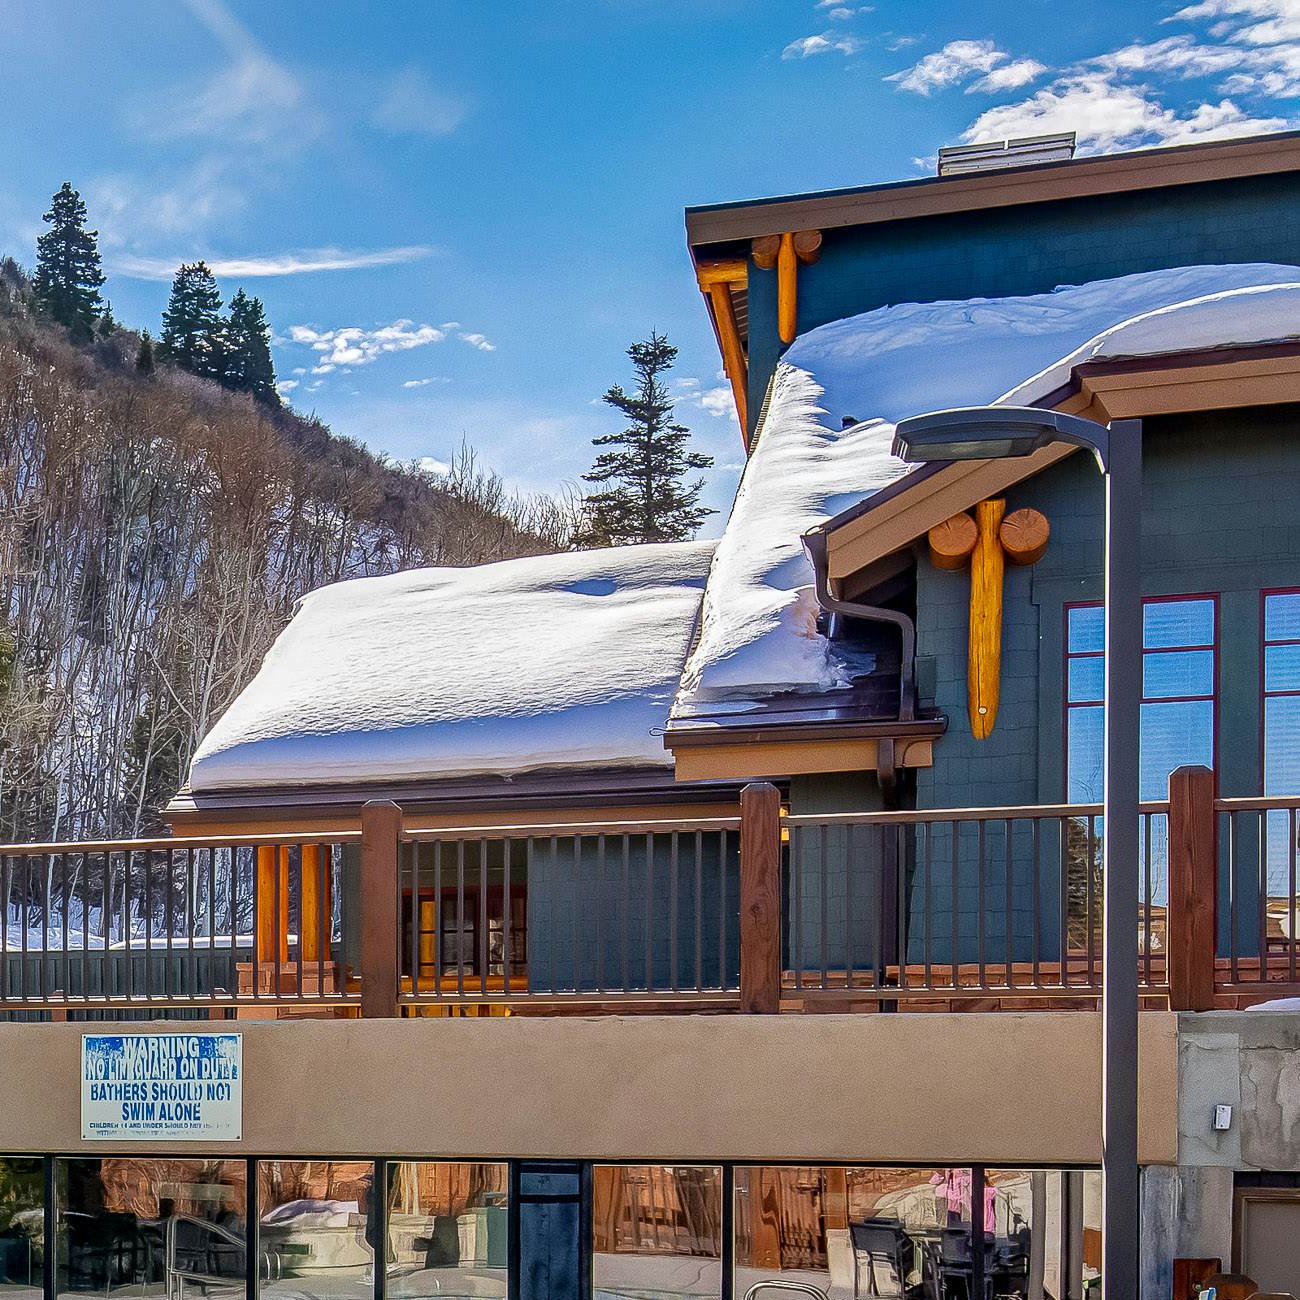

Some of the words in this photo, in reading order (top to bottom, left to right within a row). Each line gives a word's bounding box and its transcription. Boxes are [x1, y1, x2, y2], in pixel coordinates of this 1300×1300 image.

[122, 1037, 199, 1058] WARNING
[87, 1057, 106, 1081] NO
[180, 1057, 199, 1081] ON
[203, 1057, 237, 1081] DUTY
[90, 1082, 148, 1101] BATHERS
[151, 1082, 202, 1101] SHOULD
[121, 1103, 155, 1121] SWIM
[158, 1103, 201, 1121] ALONE
